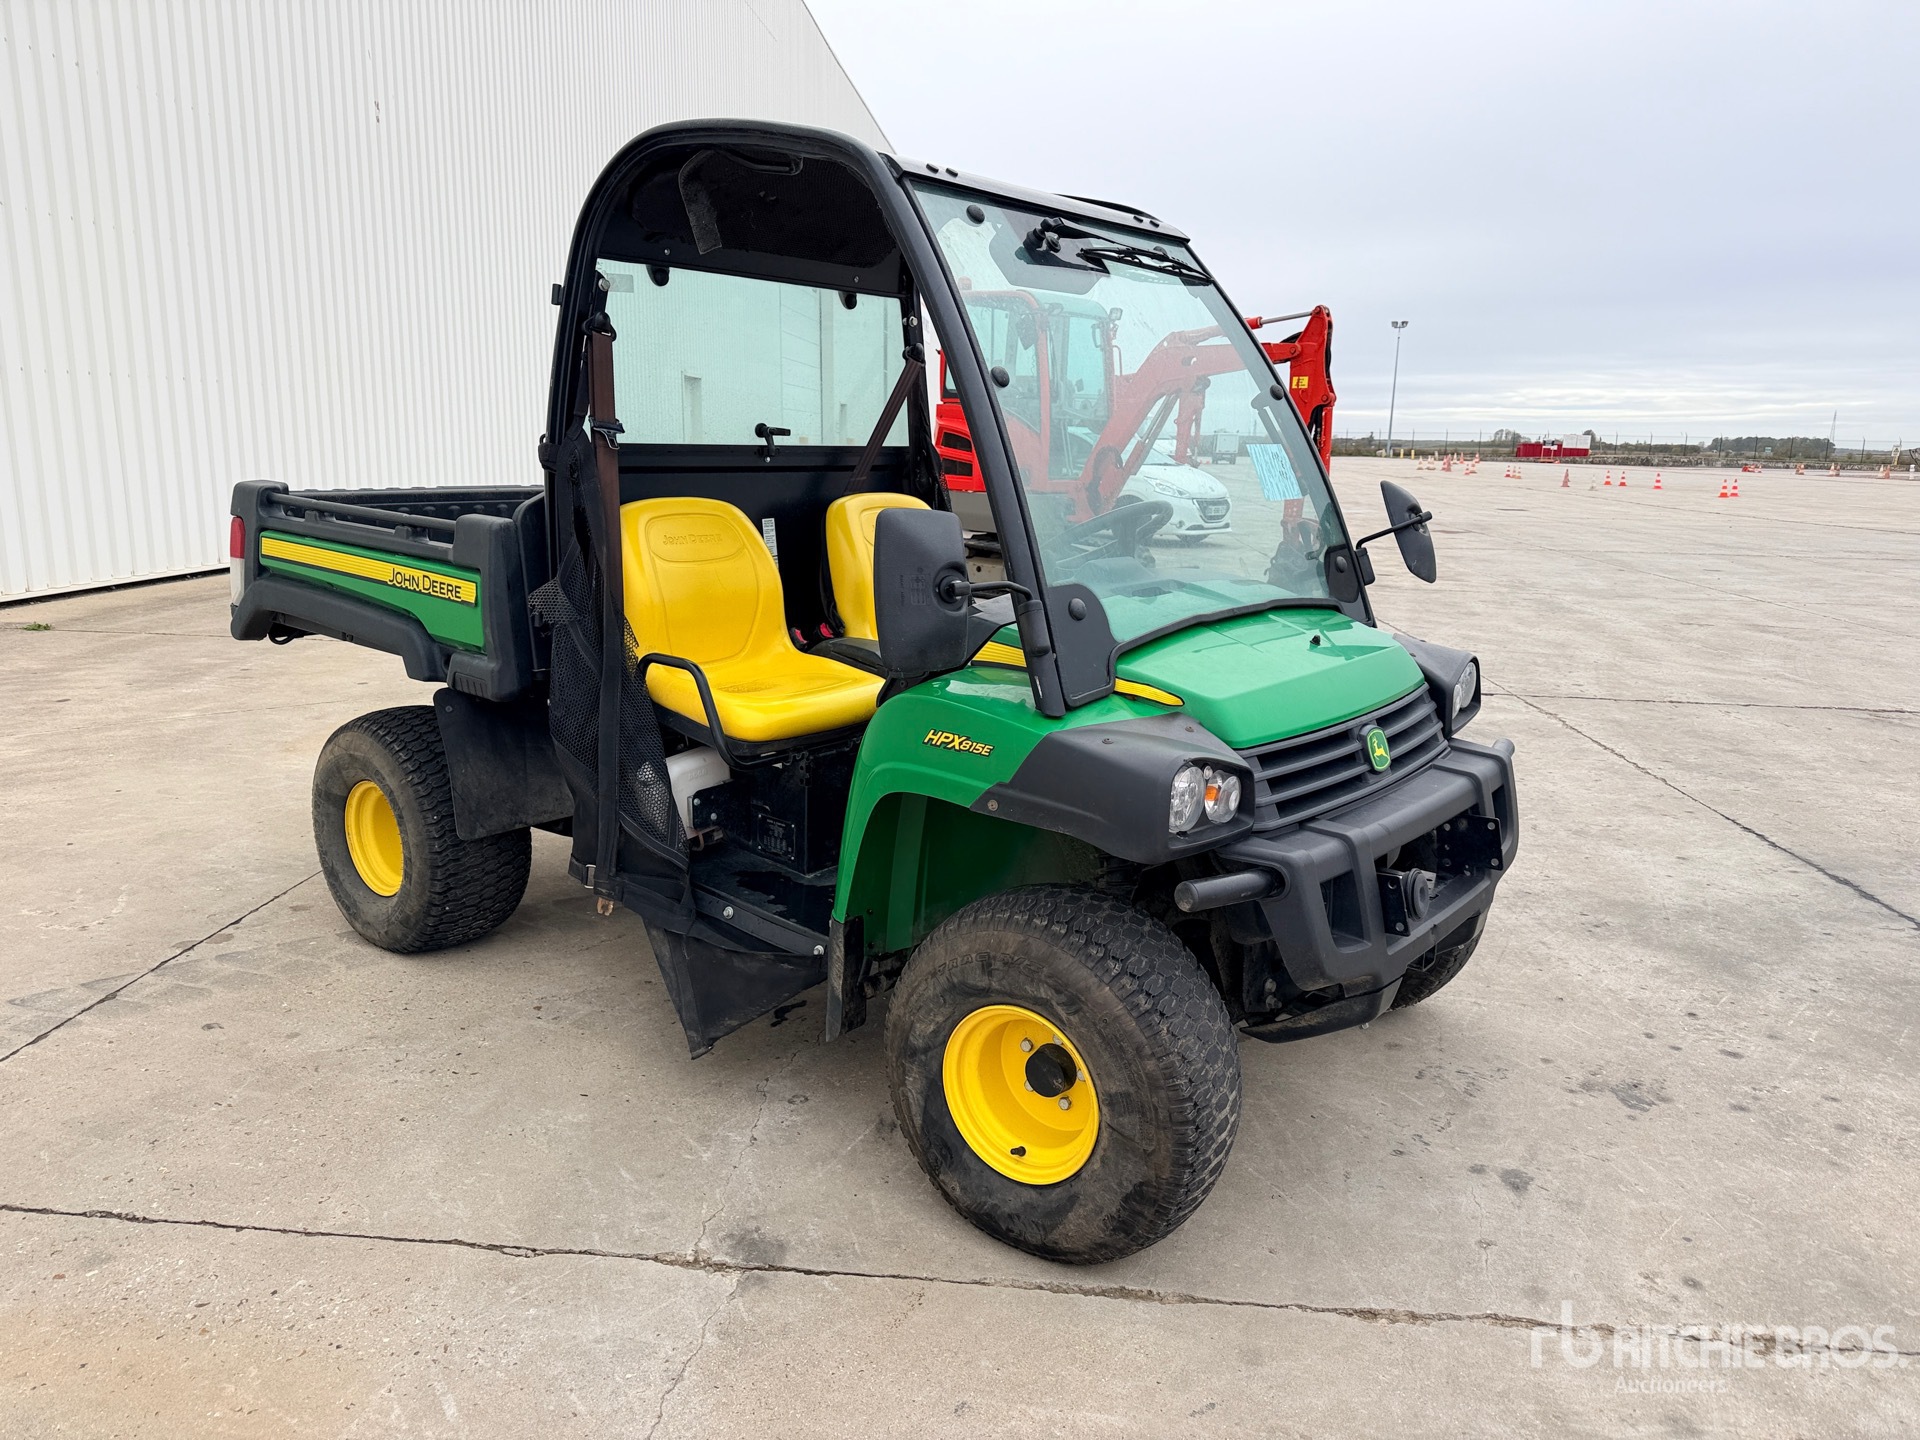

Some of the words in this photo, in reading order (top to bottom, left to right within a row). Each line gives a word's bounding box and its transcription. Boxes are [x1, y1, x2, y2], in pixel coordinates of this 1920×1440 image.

[389, 567, 420, 590] JOHN
[422, 574, 462, 600] DEERE
[923, 729, 994, 757] HPX815E
